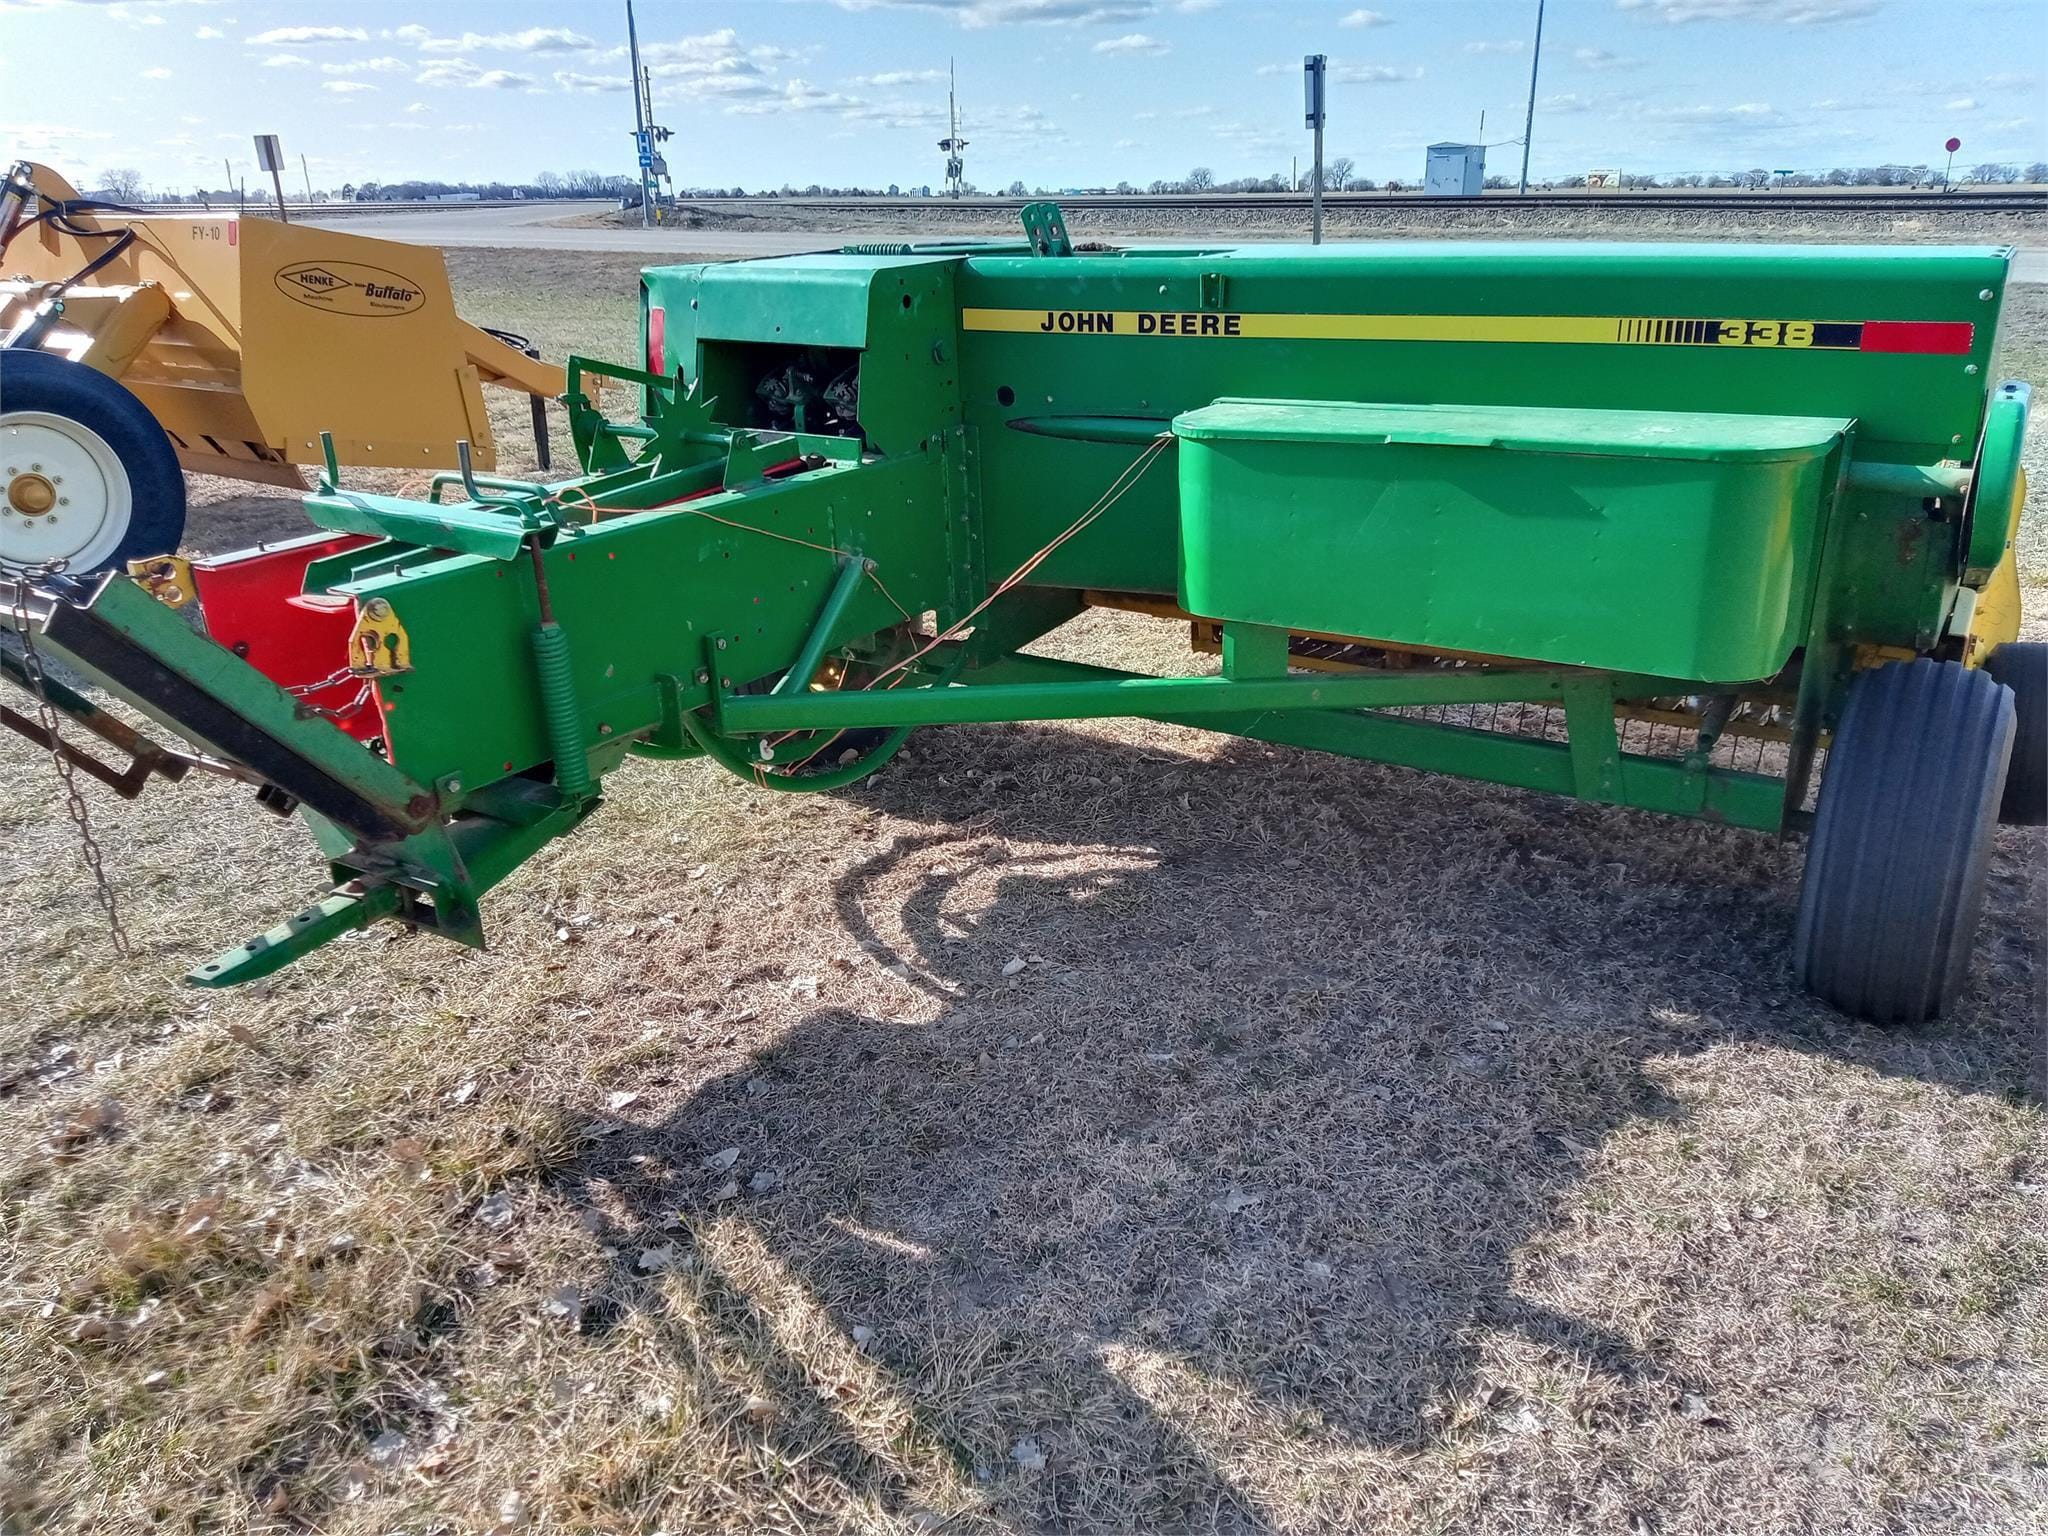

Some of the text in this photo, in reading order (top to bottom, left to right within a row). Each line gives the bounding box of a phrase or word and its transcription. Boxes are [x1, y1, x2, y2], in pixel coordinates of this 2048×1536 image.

[192, 226, 220, 240] FY-10
[300, 273, 334, 287] HENKE
[365, 283, 413, 302] Buffalo
[1041, 312, 1241, 336] JOHN DEERE
[1718, 320, 1815, 348] 338
